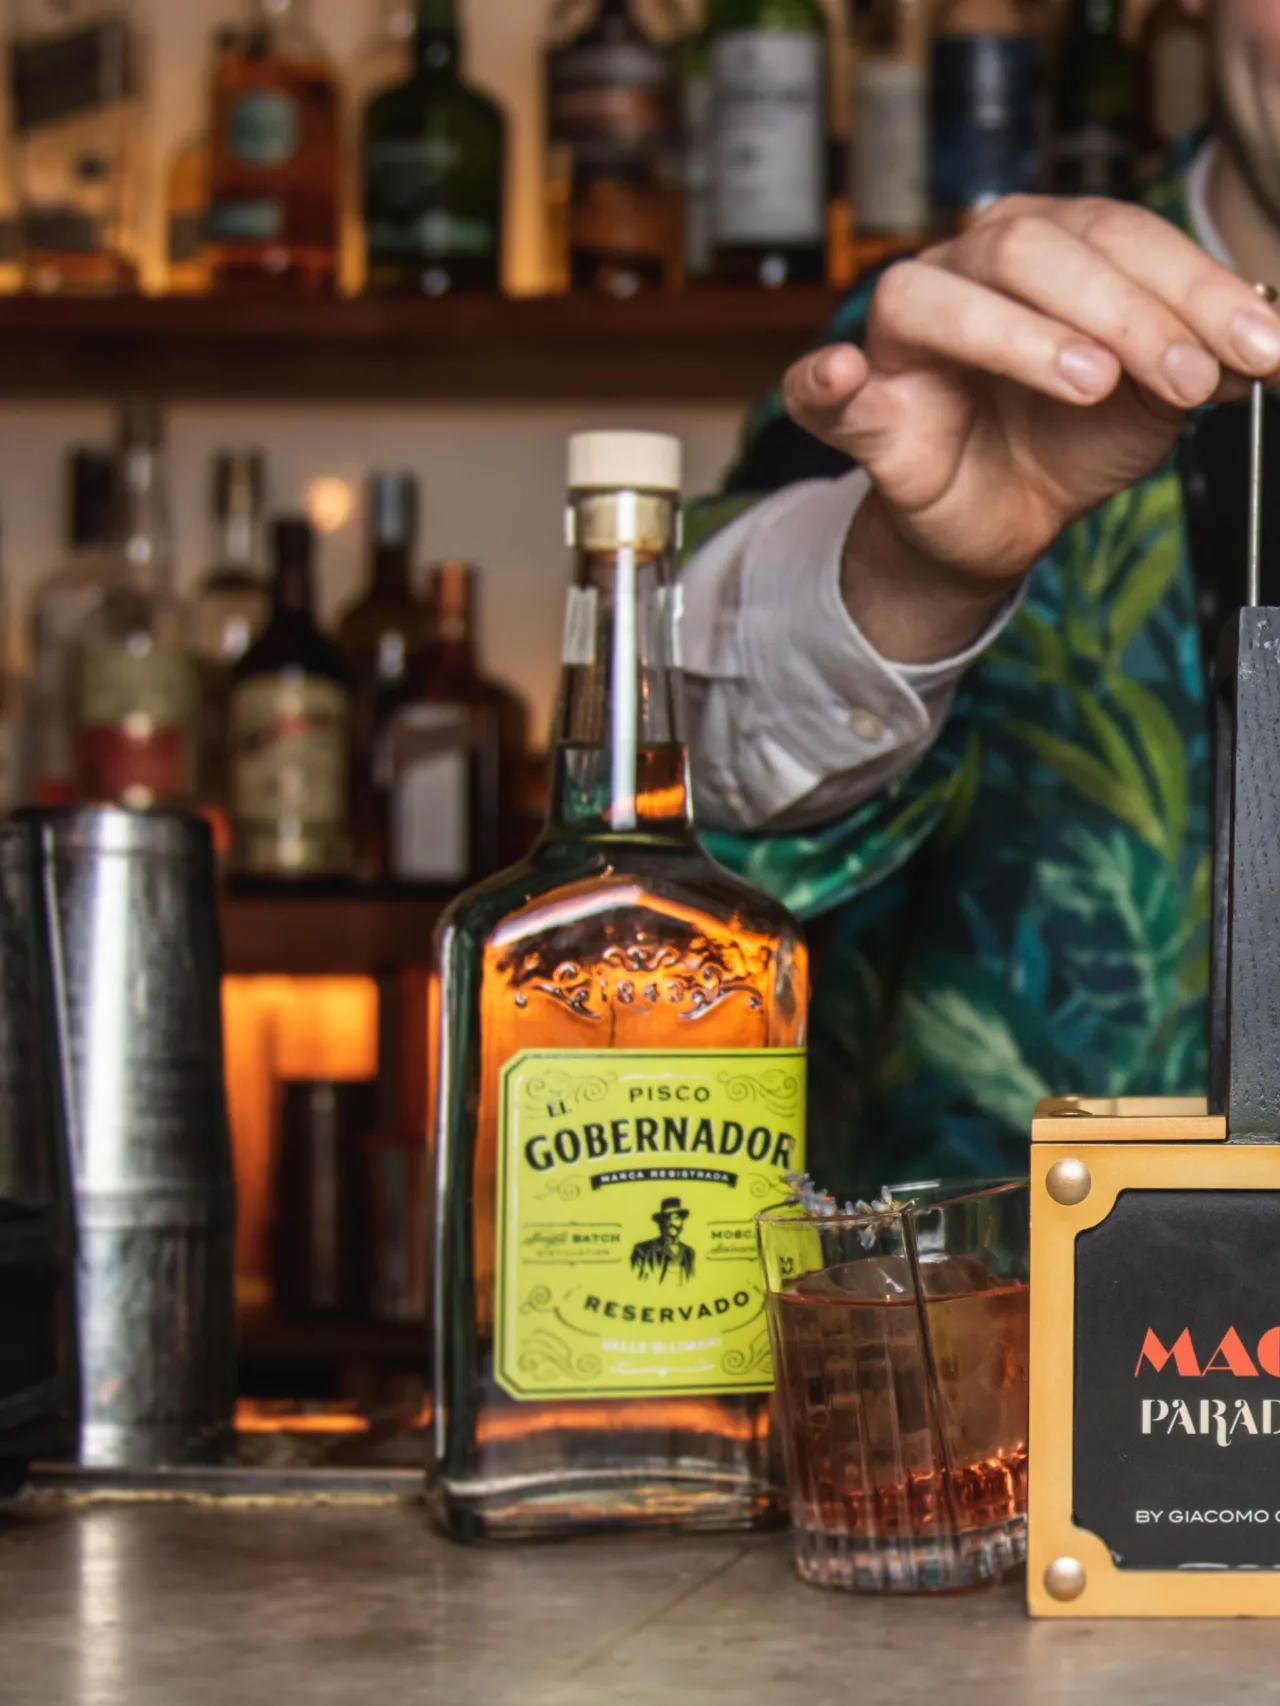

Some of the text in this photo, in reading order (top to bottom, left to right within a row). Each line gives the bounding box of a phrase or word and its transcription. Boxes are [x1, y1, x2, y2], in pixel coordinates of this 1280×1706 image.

[628, 1084, 712, 1104] PISCO
[546, 1099, 571, 1118] EL
[524, 1115, 797, 1172] GOBERNADOR
[599, 1169, 730, 1184] MARCA REGISTRADA
[571, 1232, 621, 1244] BATCH
[583, 1290, 750, 1324] RESERVADO
[1135, 1509, 1164, 1524] BY
[1168, 1509, 1270, 1524] GIACOMO
